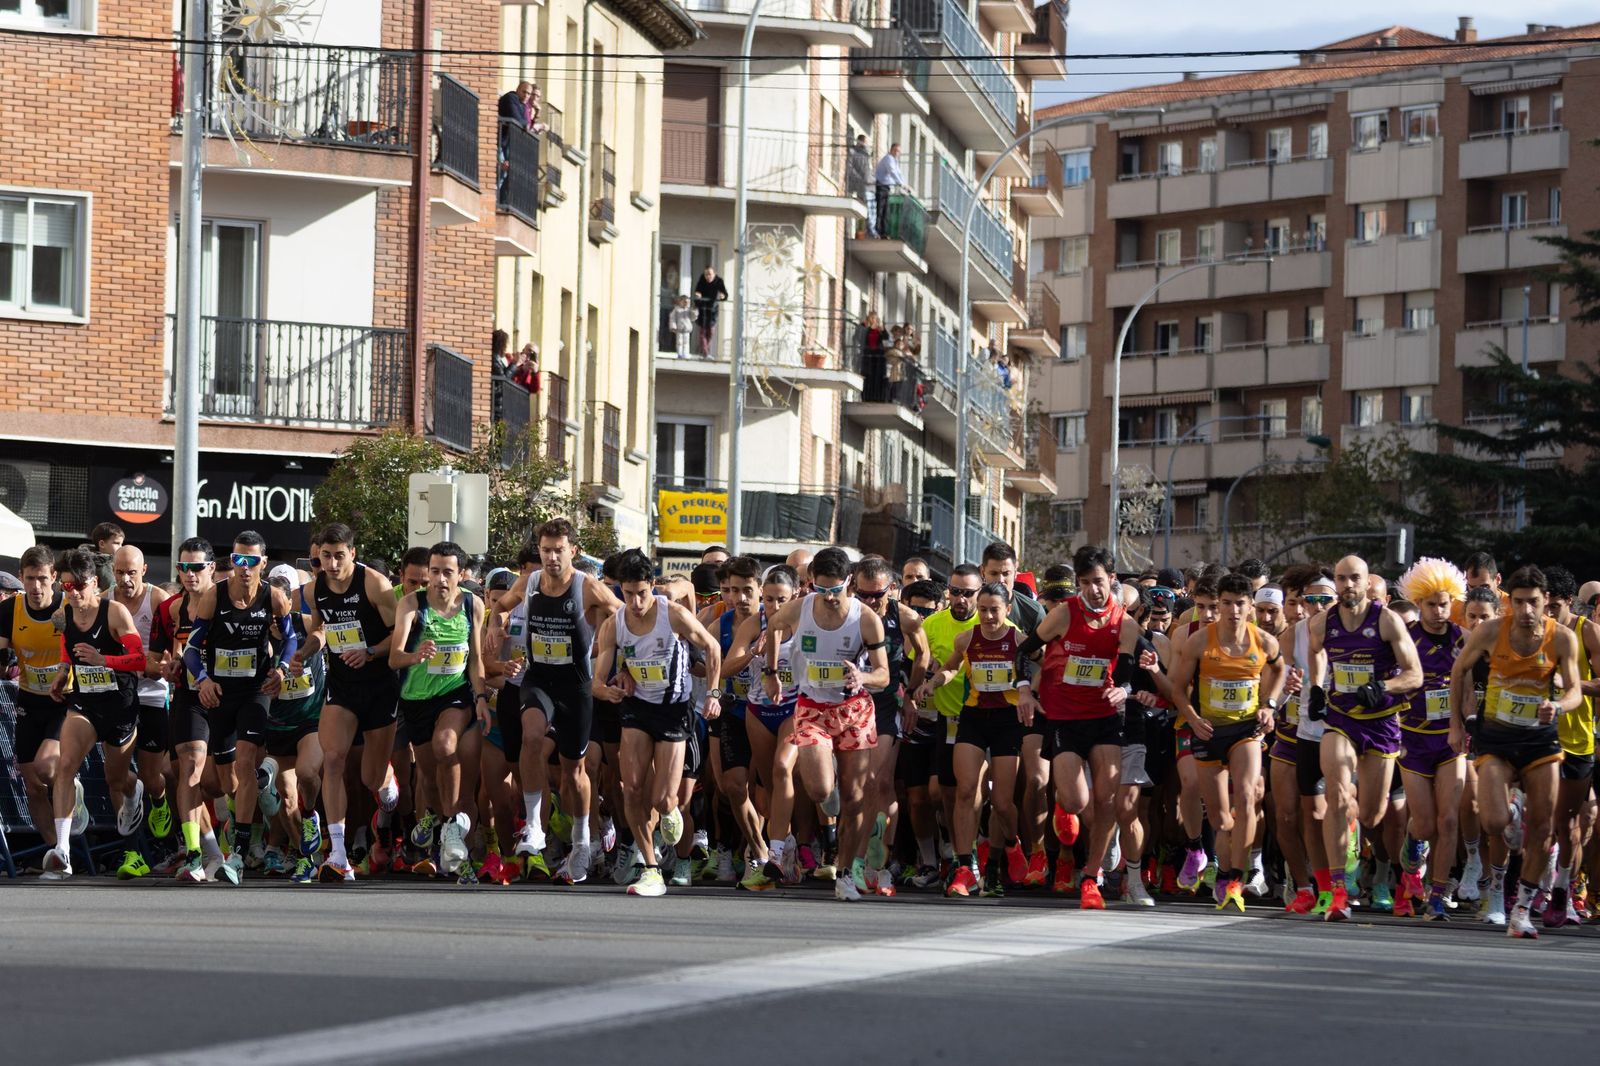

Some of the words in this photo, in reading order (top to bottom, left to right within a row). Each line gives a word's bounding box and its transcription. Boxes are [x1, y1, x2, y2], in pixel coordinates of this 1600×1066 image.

[118, 485, 159, 500] Estrella
[118, 499, 157, 512] Galicia
[679, 514, 721, 525] BIPER
[336, 631, 346, 643] 14
[545, 643, 552, 655] 3
[228, 656, 239, 668] 16
[444, 652, 451, 665] 2
[640, 667, 648, 679] 9
[819, 668, 829, 679] 10
[986, 670, 993, 682] 6
[1076, 664, 1093, 677] 102
[80, 673, 105, 684] 5789
[284, 678, 298, 691] 24
[1222, 688, 1237, 700] 28
[1510, 701, 1525, 714] 27
